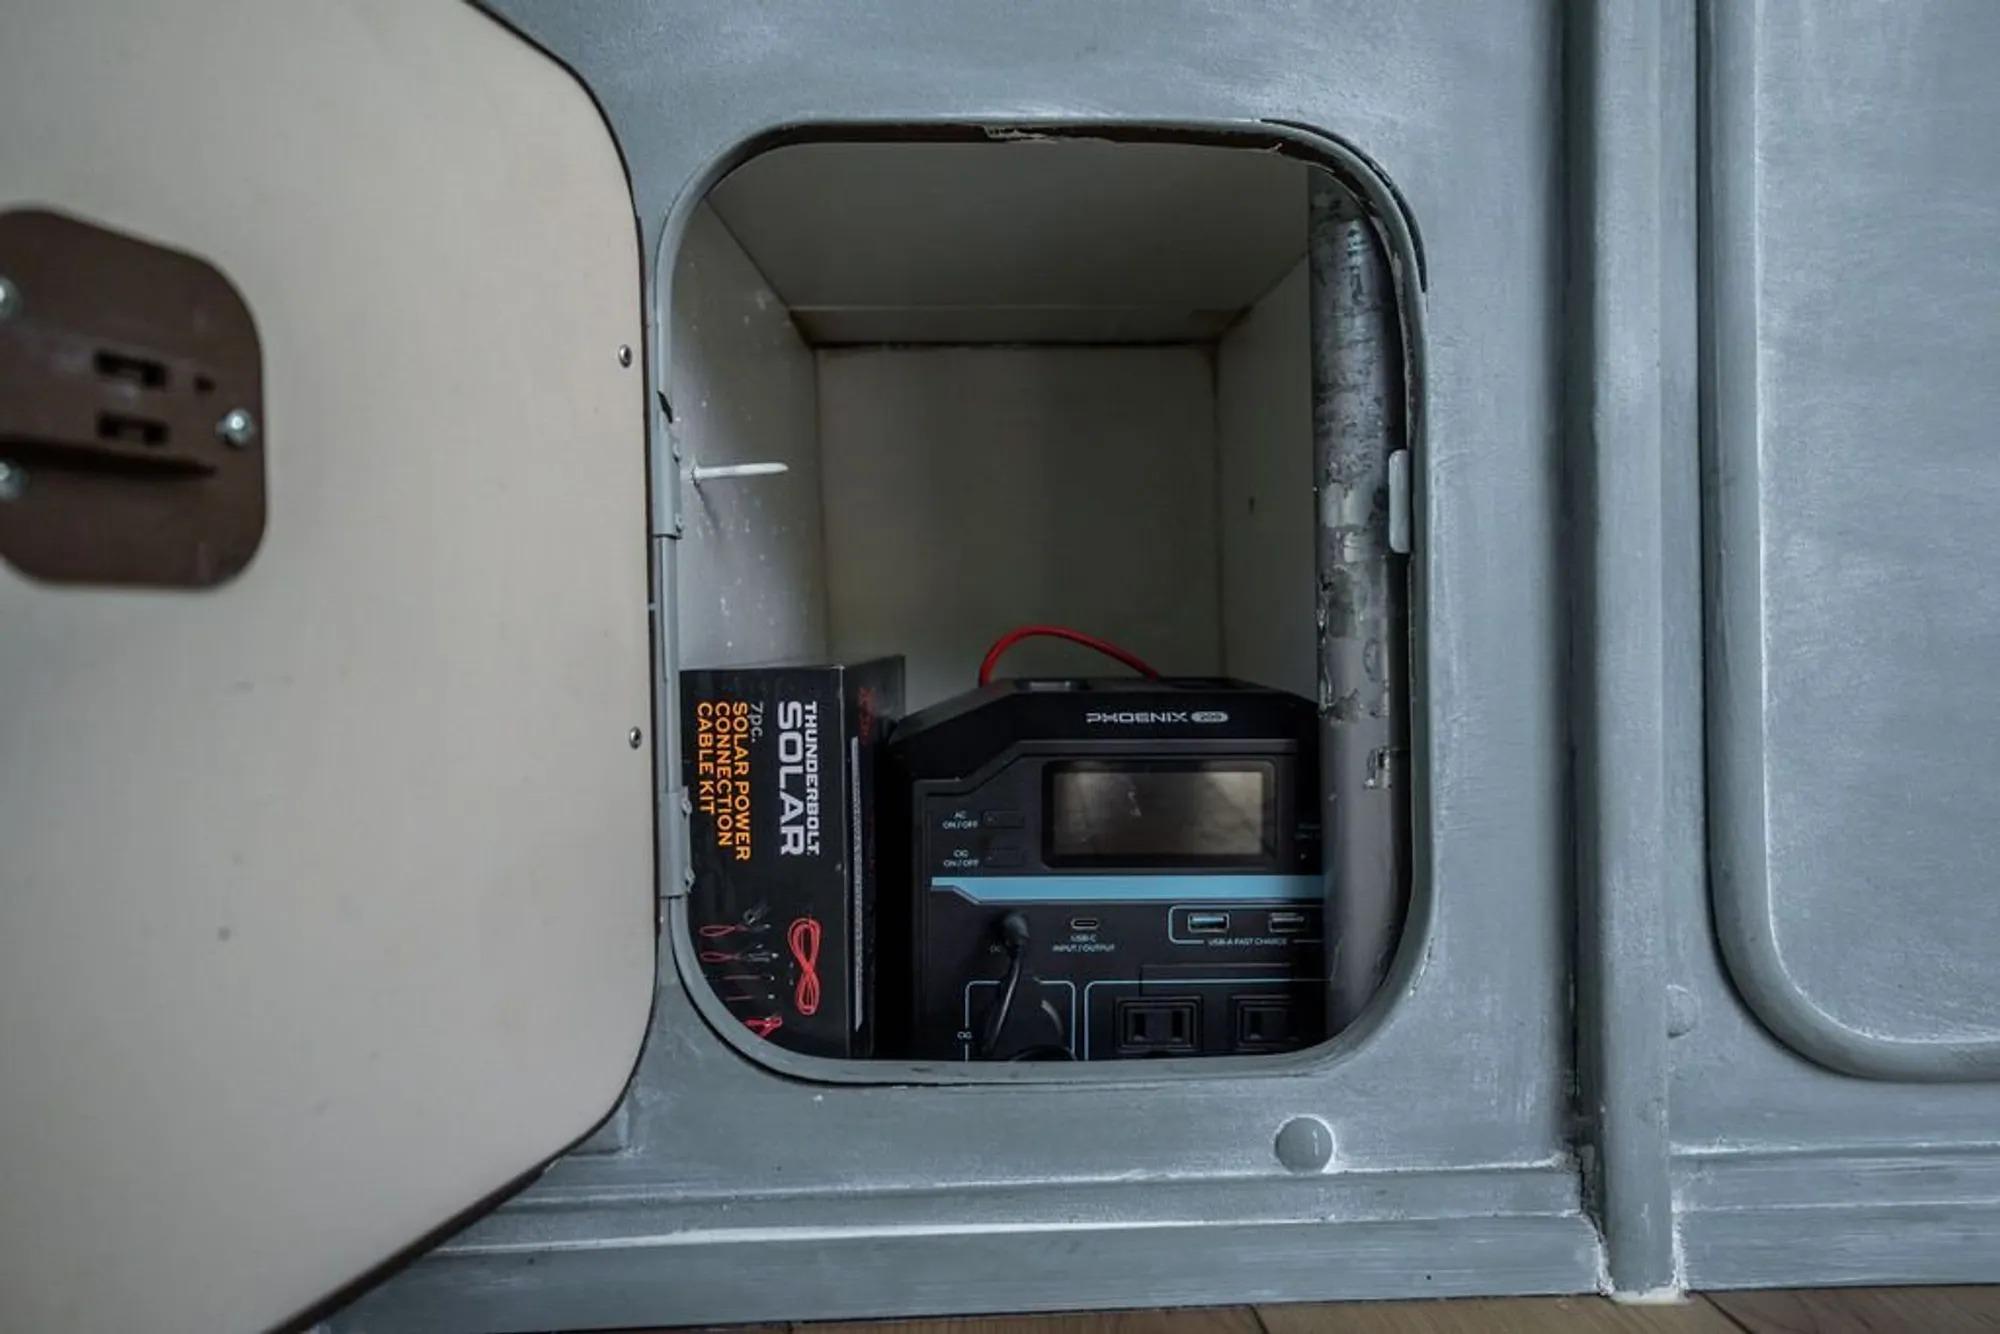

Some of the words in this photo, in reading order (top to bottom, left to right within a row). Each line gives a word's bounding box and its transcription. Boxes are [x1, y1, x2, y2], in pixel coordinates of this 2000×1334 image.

[697, 702, 714, 775] CABLE
[733, 702, 750, 776] SOLAR
[1086, 712, 1188, 722] PHOENIX
[699, 780, 715, 815] KIT
[715, 702, 733, 847] CONNECTION
[778, 701, 806, 856] SOLAR
[805, 701, 820, 855] THUNDERBOLT
[734, 780, 751, 861] POWER
